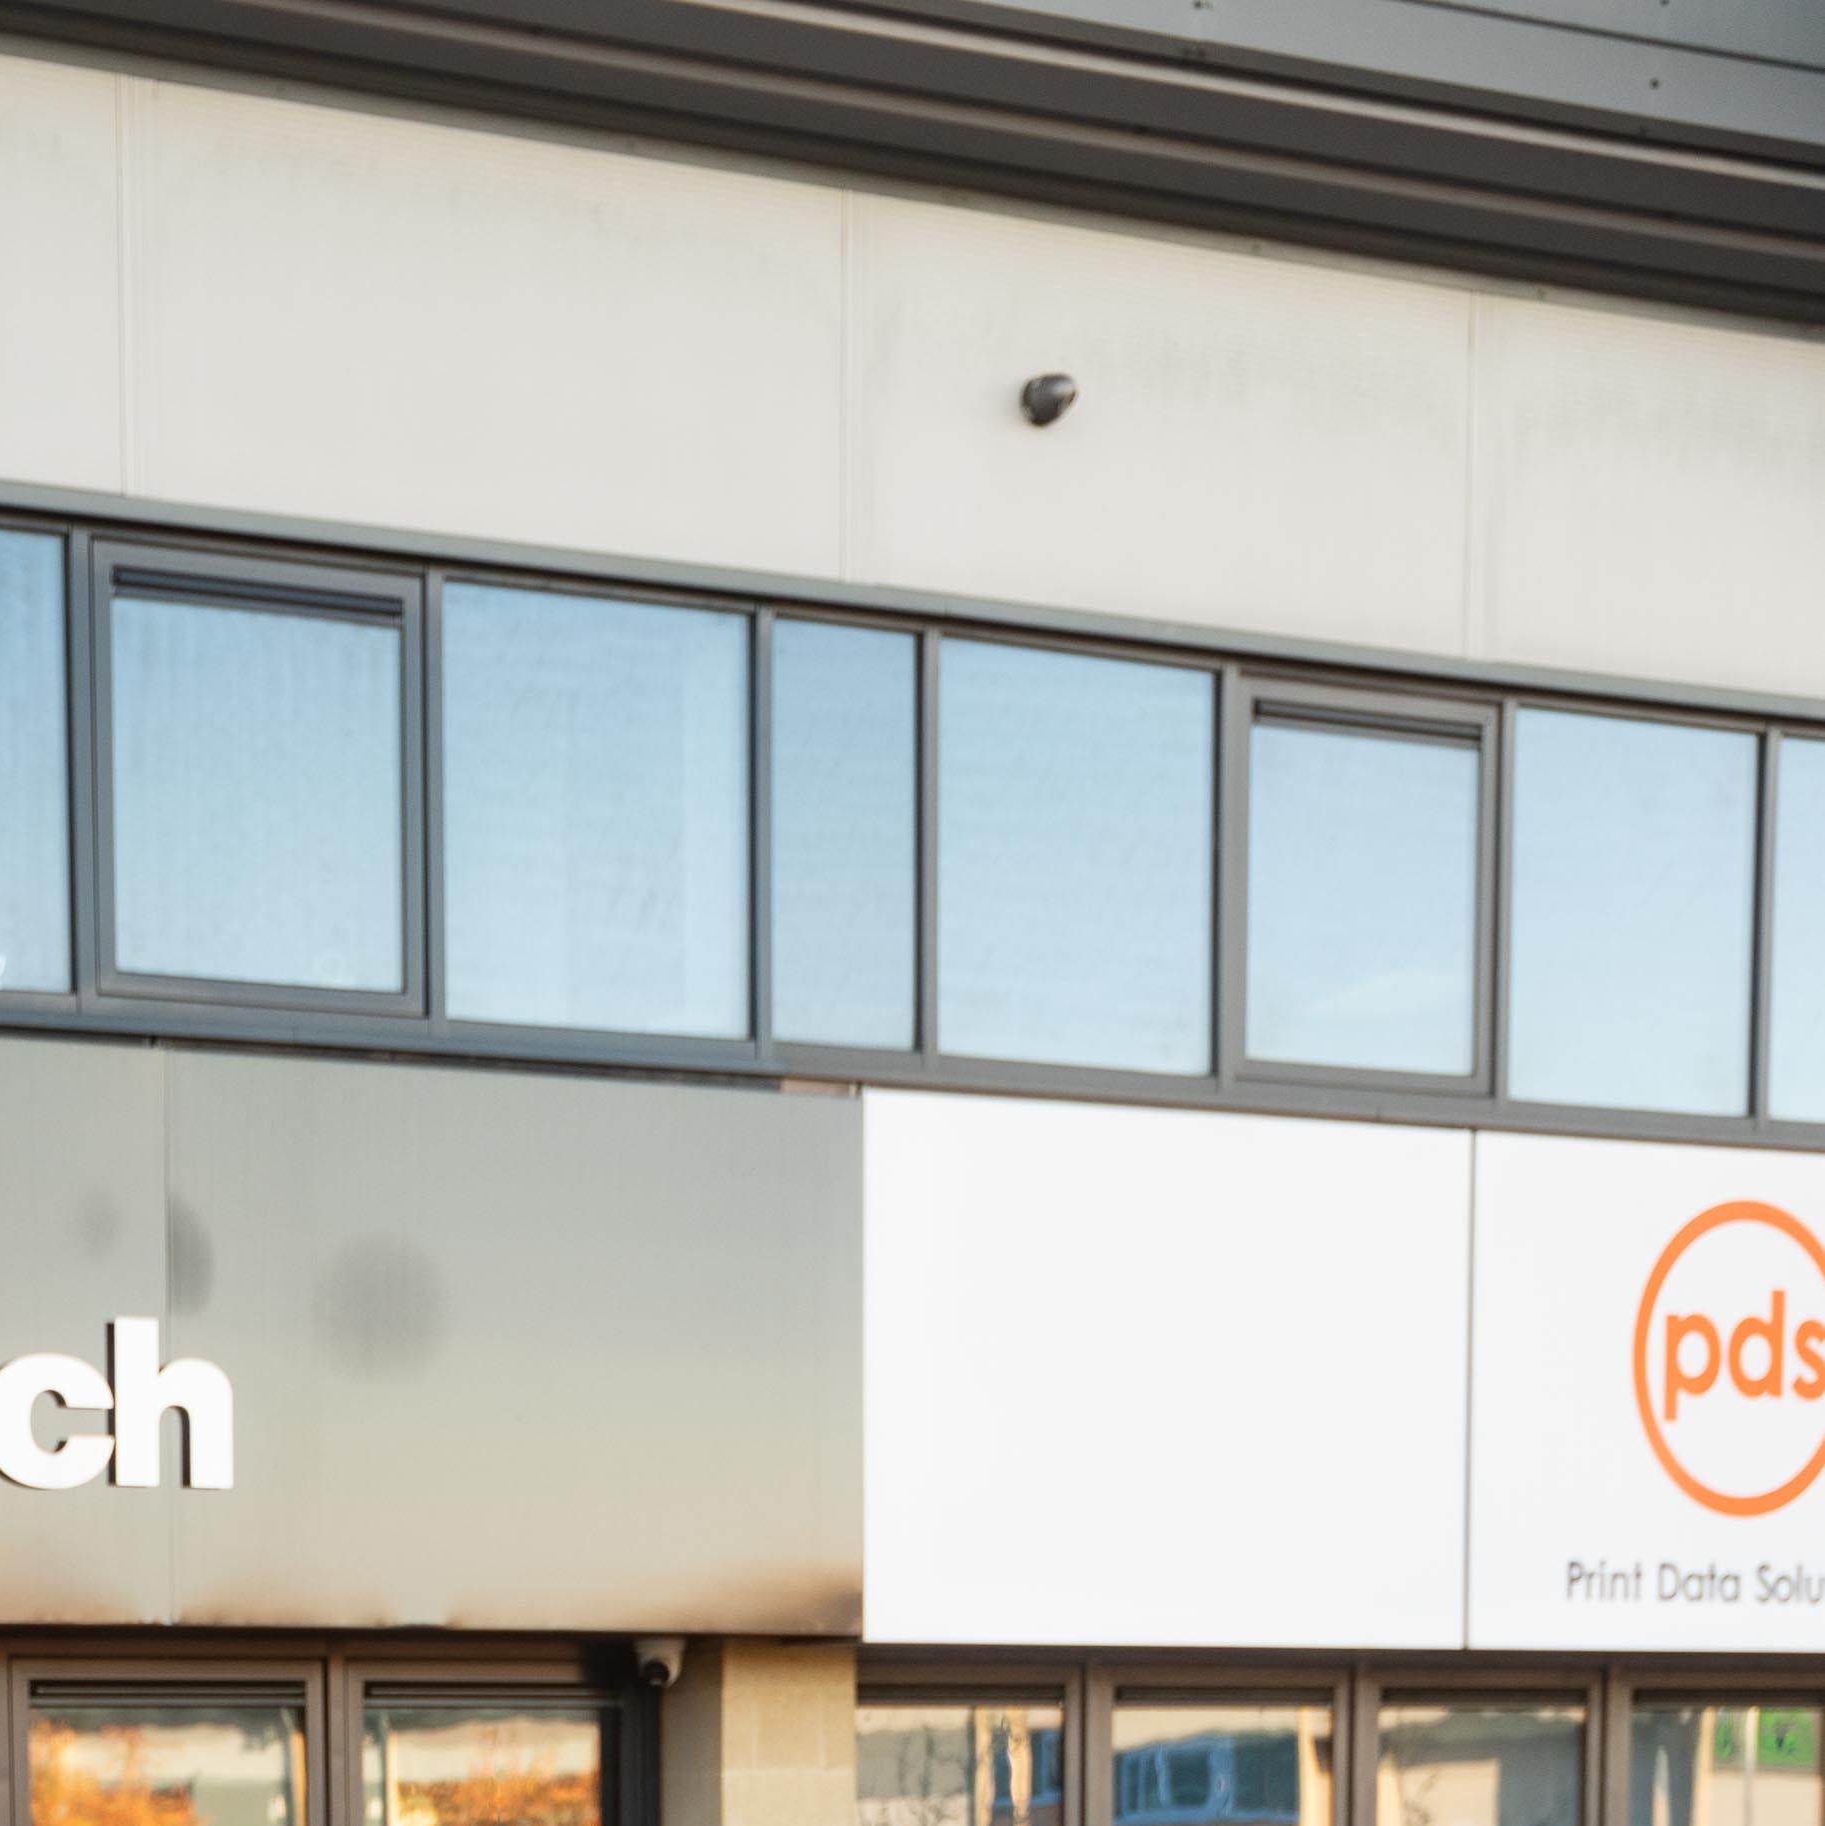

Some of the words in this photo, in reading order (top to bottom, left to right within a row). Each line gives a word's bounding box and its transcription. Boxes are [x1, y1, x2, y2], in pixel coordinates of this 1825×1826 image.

[1664, 1289, 1825, 1421] pds
[1566, 1560, 1642, 1601] Print
[1658, 1561, 1742, 1602] Data
